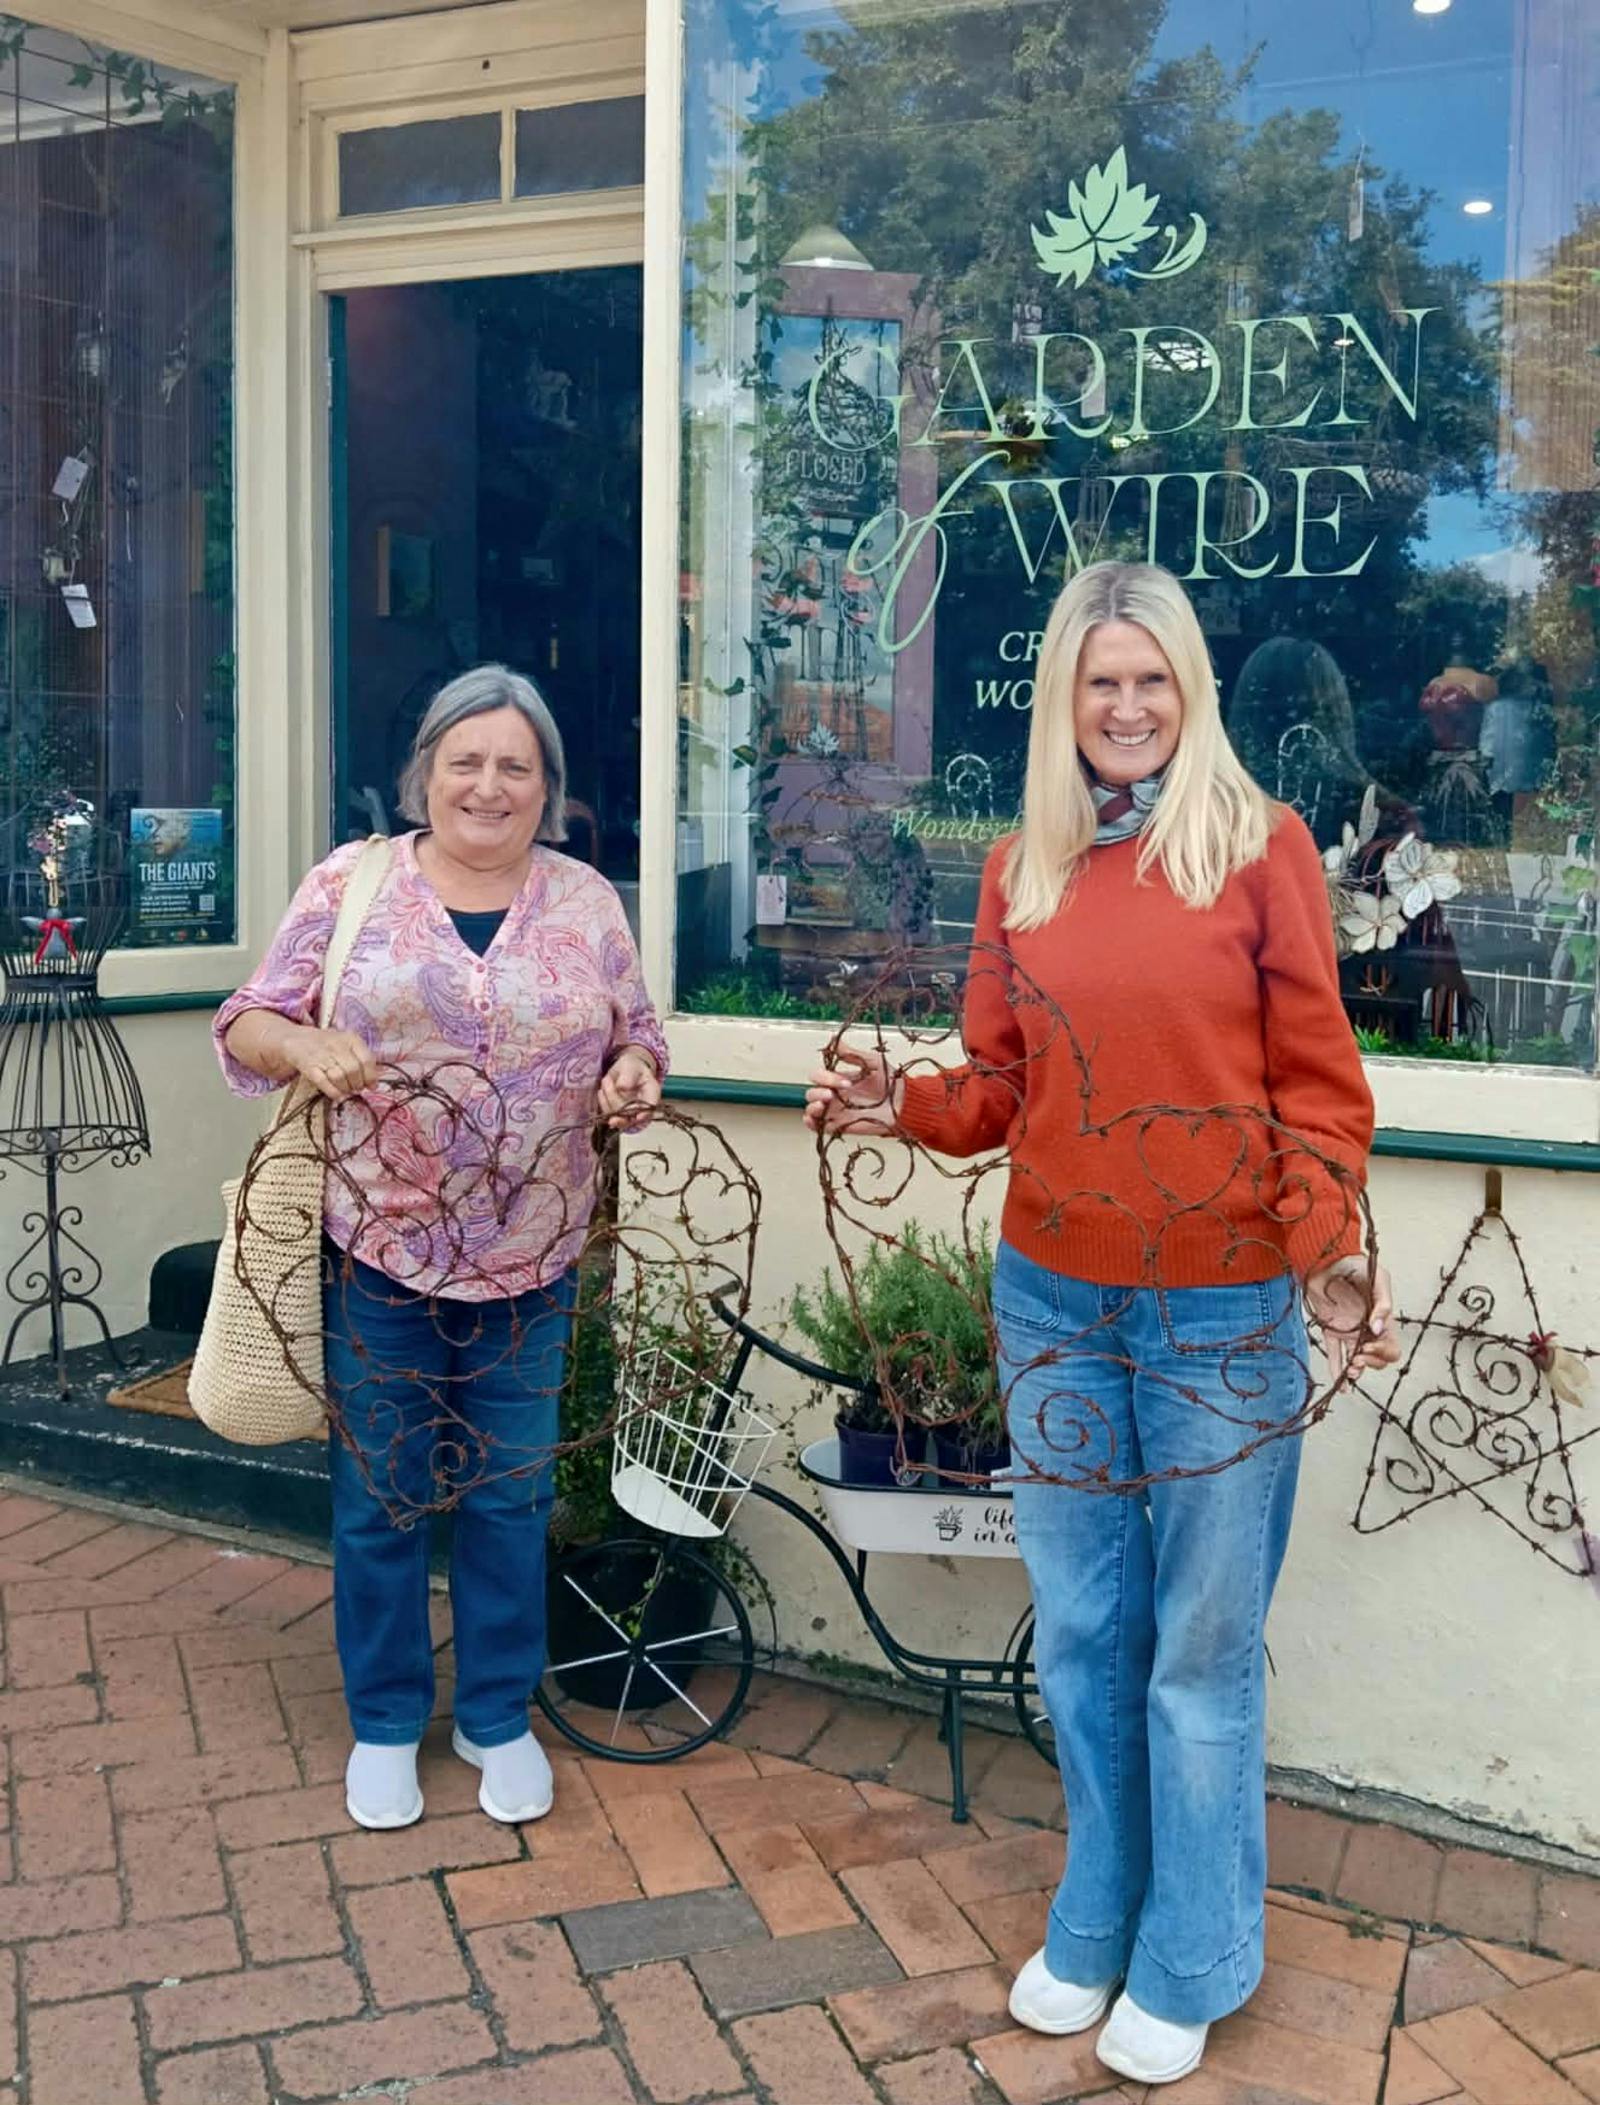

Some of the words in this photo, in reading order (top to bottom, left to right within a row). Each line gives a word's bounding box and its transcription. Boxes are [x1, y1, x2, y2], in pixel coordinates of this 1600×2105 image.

[808, 308, 1442, 452] GARDEN
[847, 449, 1011, 653] of
[978, 465, 1378, 585] WIRE
[139, 863, 165, 881] THE
[168, 861, 216, 881] GIANTS
[974, 1527, 999, 1543] in
